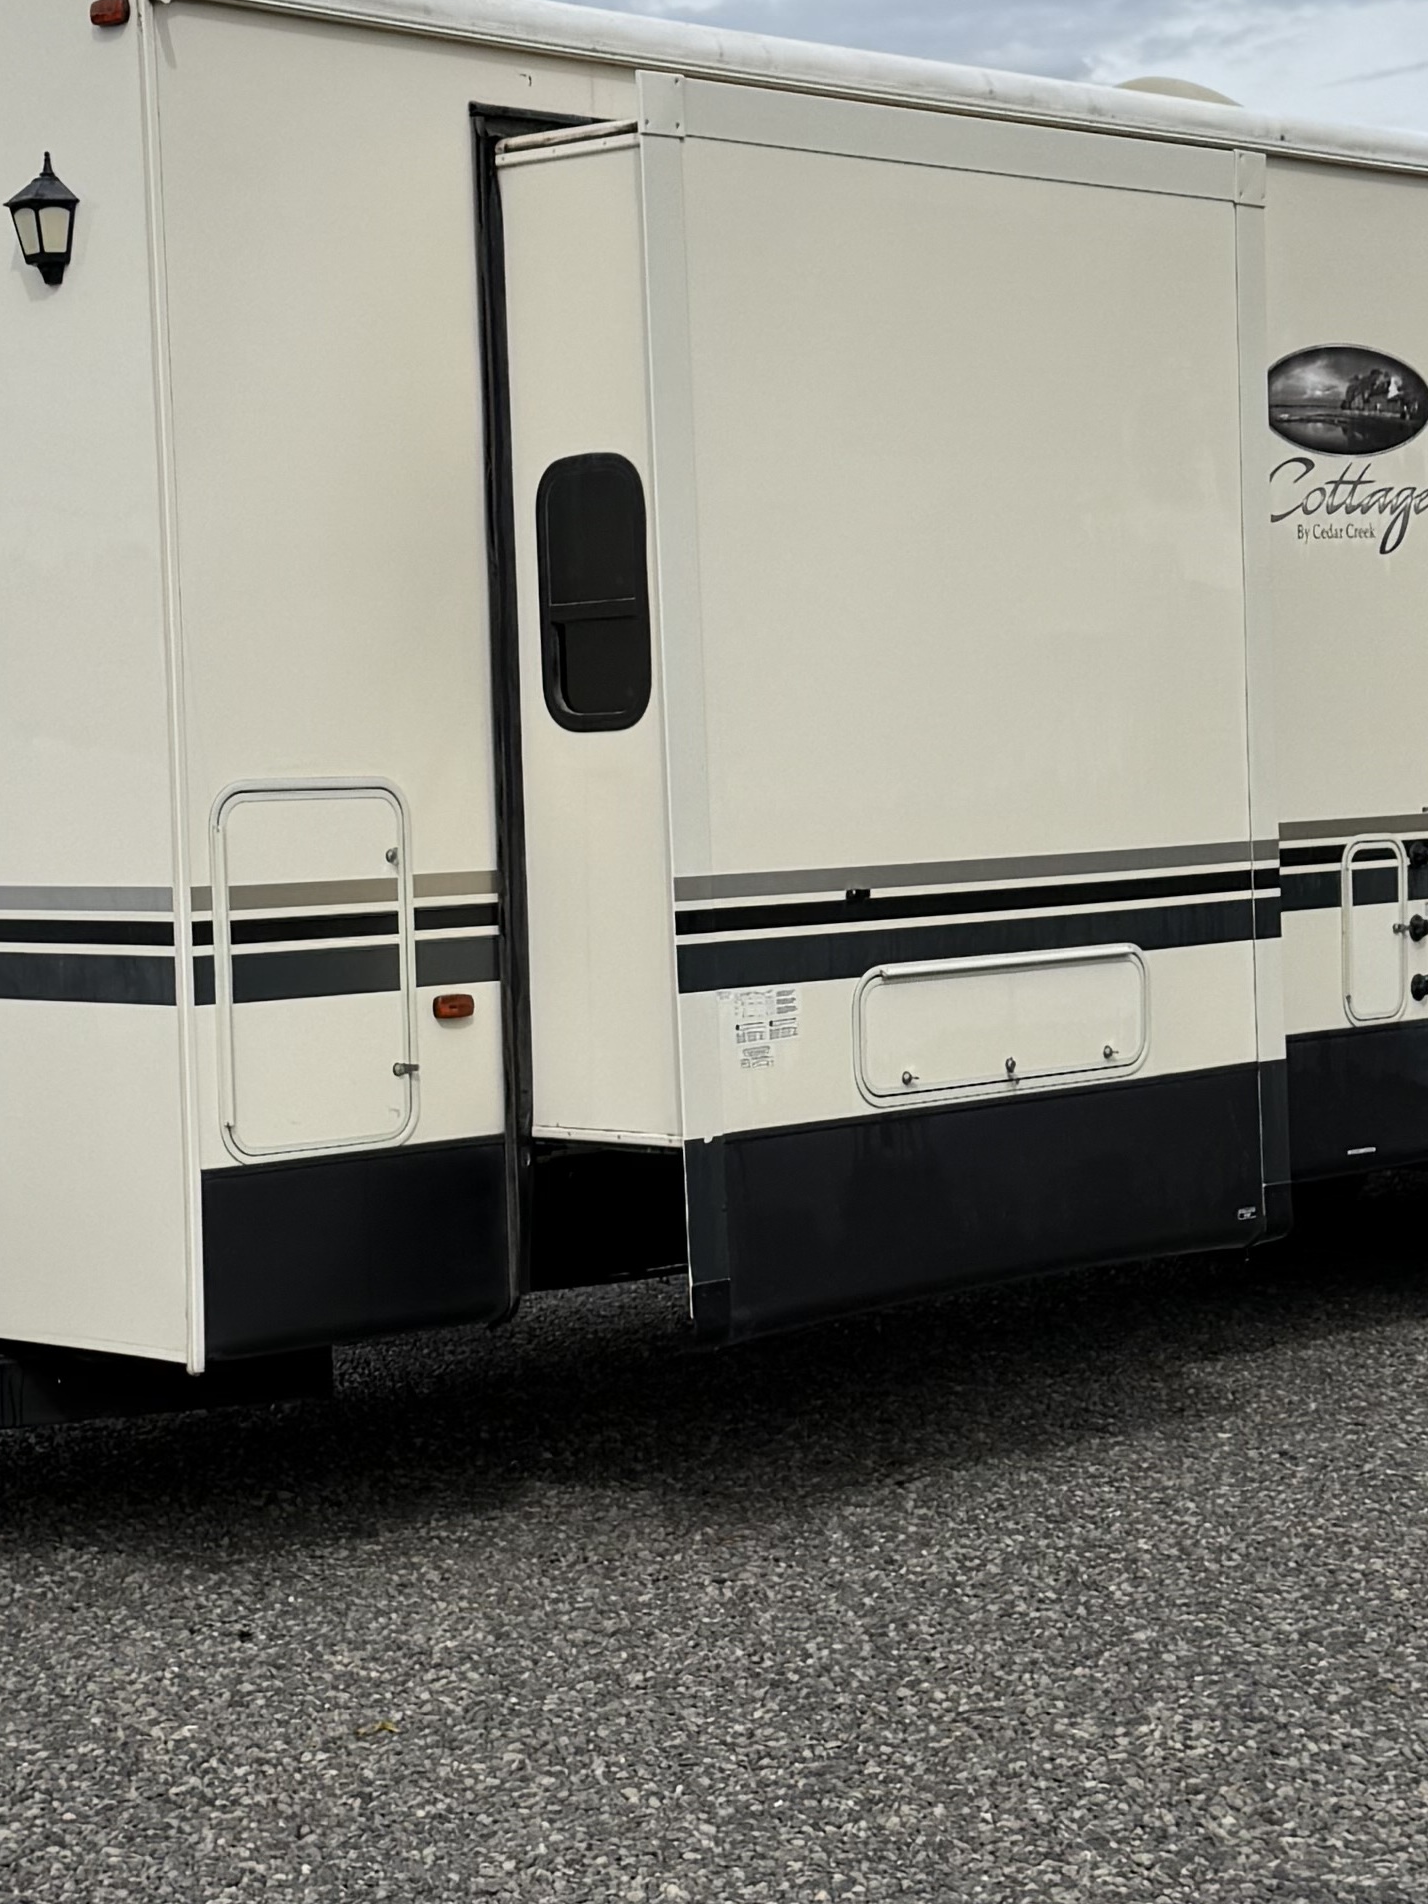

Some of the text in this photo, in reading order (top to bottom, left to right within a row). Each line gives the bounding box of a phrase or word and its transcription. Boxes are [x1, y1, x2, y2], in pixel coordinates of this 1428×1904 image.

[1297, 522, 1376, 544] By Cedar Creek
